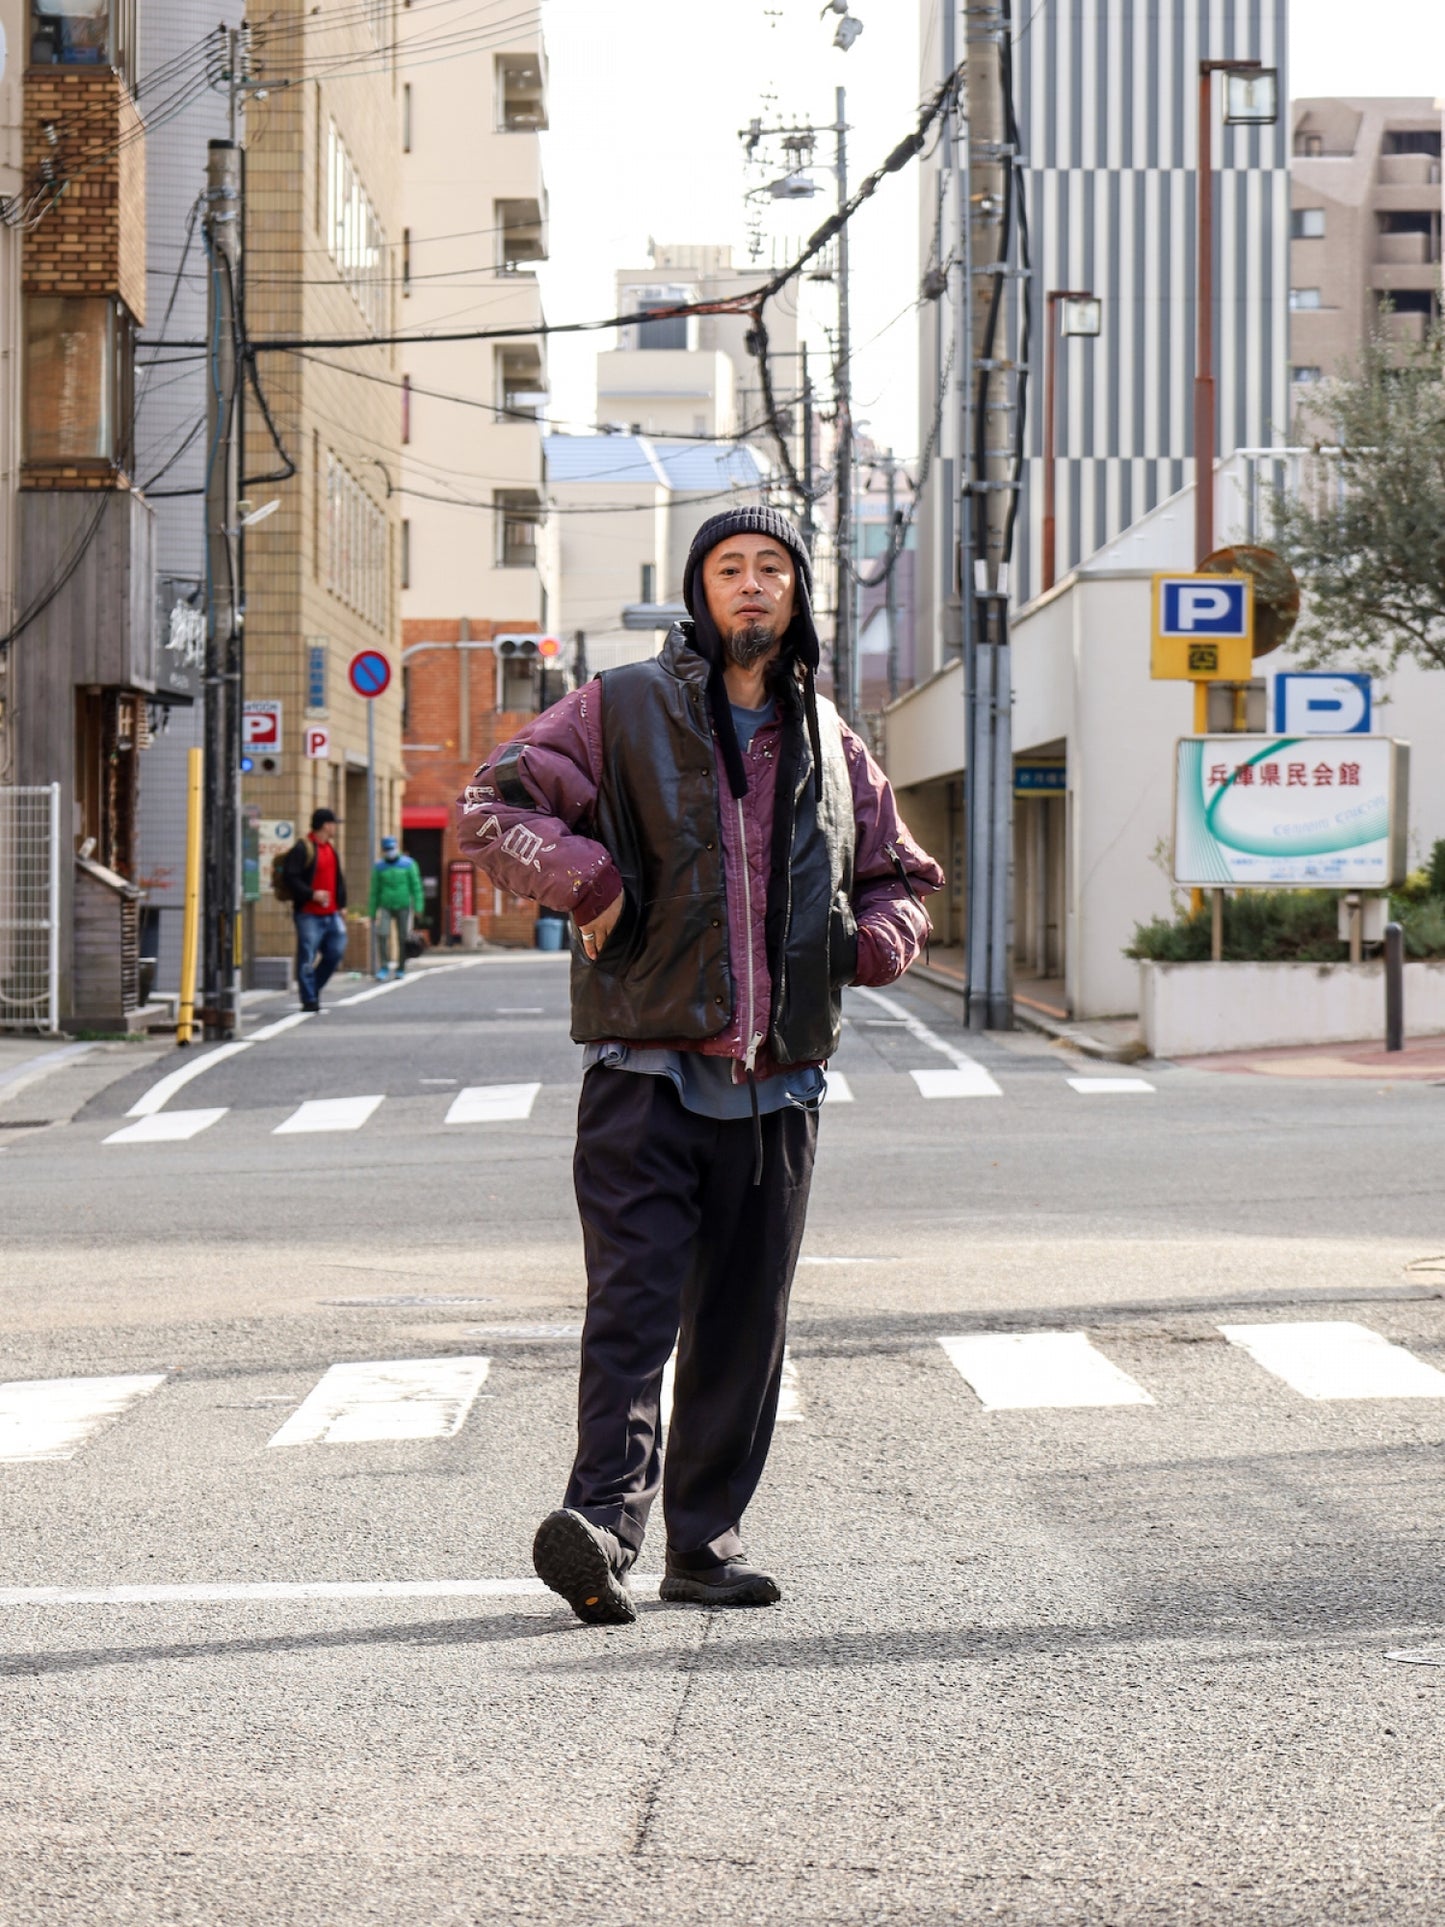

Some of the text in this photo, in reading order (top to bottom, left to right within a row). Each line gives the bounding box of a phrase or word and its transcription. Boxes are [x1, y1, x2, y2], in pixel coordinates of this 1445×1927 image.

[1178, 587, 1231, 630] P
[1285, 677, 1365, 733] P
[243, 715, 273, 743] P
[311, 732, 326, 754] P
[1208, 762, 1361, 787] 兵庫県民会館
